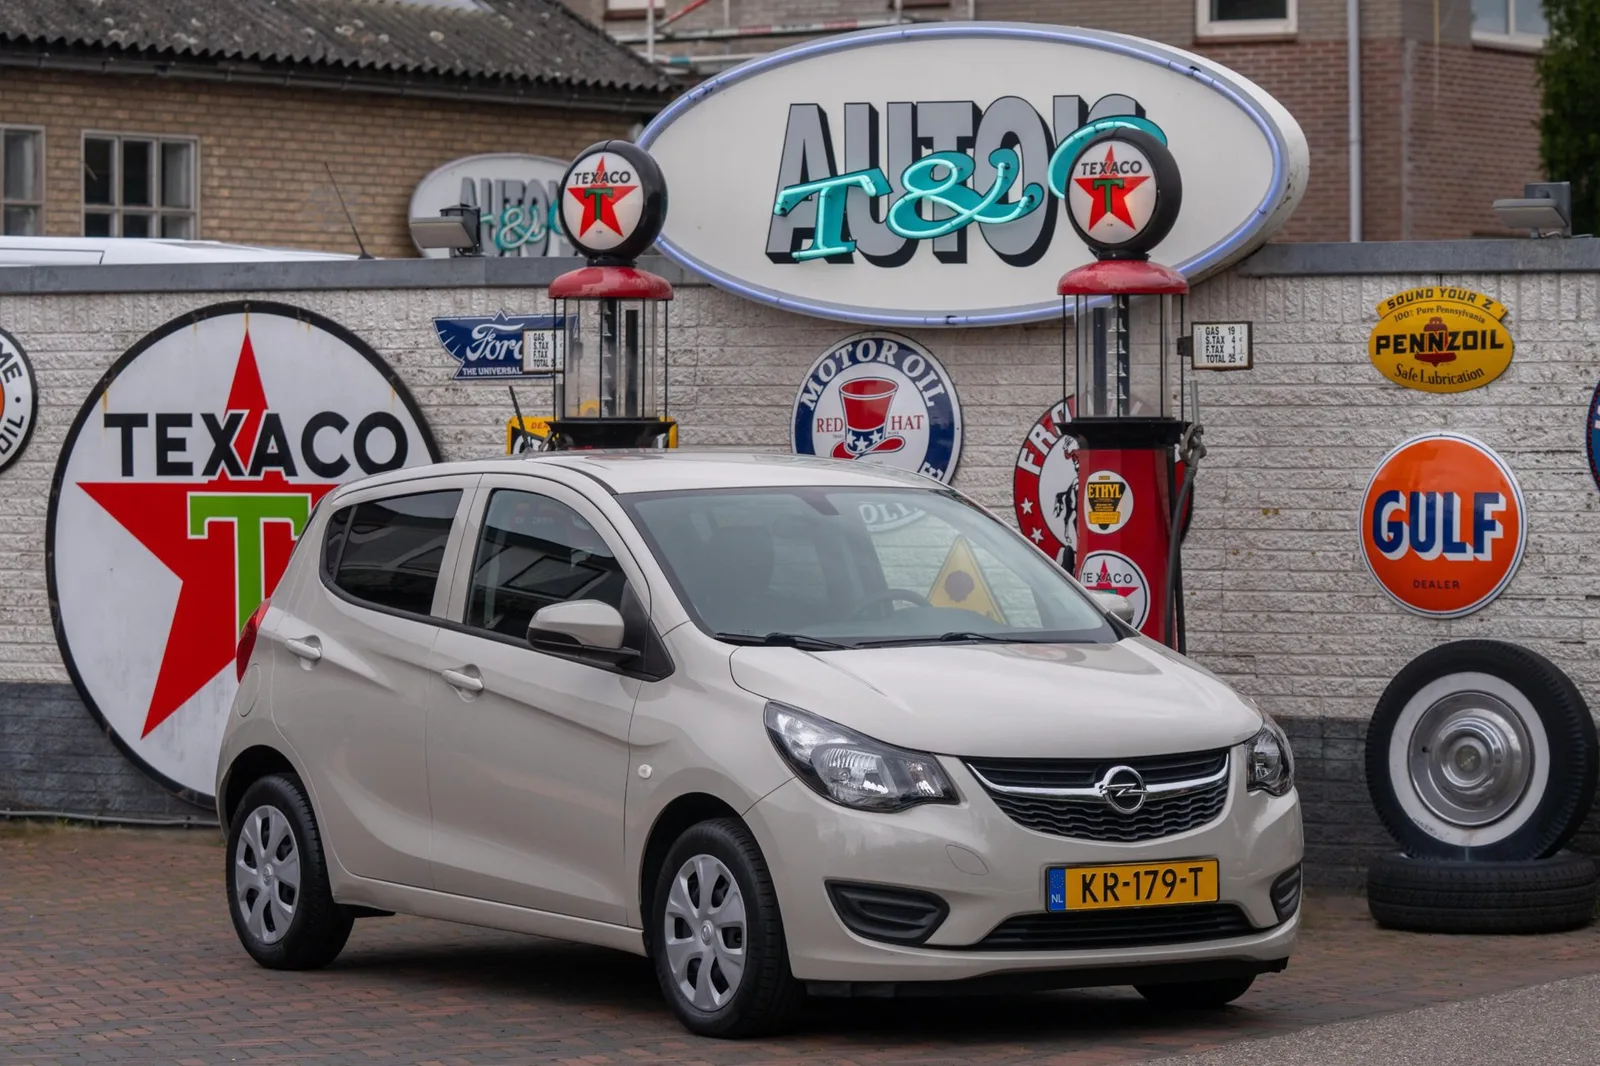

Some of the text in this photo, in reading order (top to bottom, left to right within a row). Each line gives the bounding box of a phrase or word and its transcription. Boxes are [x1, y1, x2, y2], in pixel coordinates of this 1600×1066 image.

[1081, 161, 1142, 175] TEXACO
[575, 171, 631, 185] TEXACO
[1387, 287, 1494, 310] SOUND YOUR Z
[1416, 306, 1434, 316] Pure
[1436, 305, 1485, 324] Pennsylvania
[533, 333, 545, 341] GAS
[1205, 326, 1235, 335] GAS 19
[533, 342, 549, 350] S.TAX
[1205, 336, 1225, 344] S.TAX
[1375, 329, 1505, 355] PENNZOIL
[533, 351, 548, 359] F.TAX
[1205, 345, 1224, 354] F.TAX
[534, 359, 549, 367] TOTAL
[1206, 355, 1226, 363] TOTAL
[463, 366, 522, 375] THE UNIVERSAL
[800, 339, 945, 411] MOTOR OIL
[1394, 363, 1485, 385] Safe Lubrication
[816, 415, 924, 433] RED HAT
[104, 410, 408, 478] TEXACO
[1088, 484, 1121, 498] ETHYL
[1372, 490, 1506, 561] GULF
[1083, 572, 1133, 584] TEXACO
[1413, 580, 1460, 589] DEALER
[1081, 867, 1203, 903] KR-179-T
[1051, 894, 1064, 903] NL
